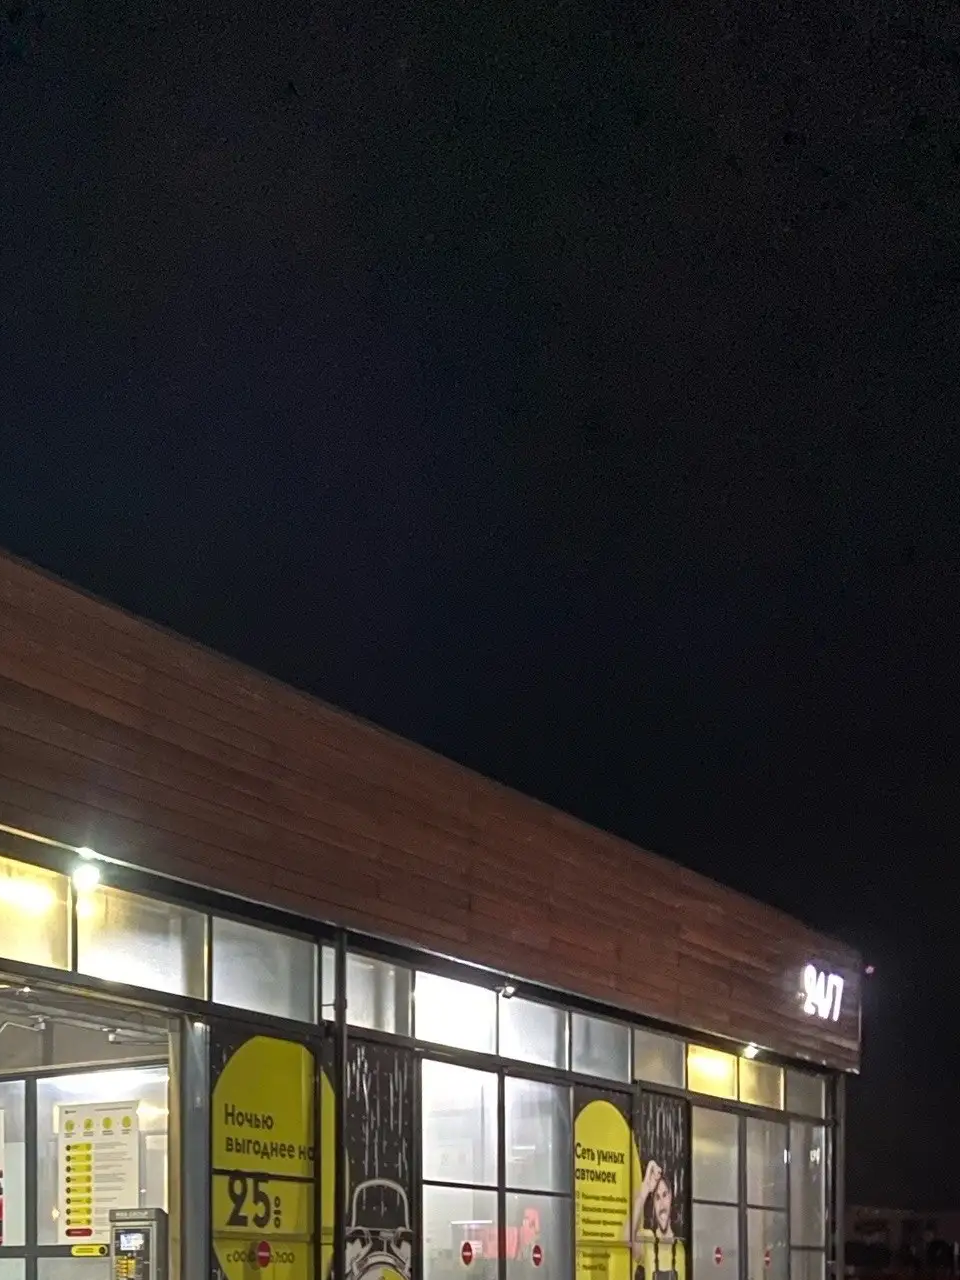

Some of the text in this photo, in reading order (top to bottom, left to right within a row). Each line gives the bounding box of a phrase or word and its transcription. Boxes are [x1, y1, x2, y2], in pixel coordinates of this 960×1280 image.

[224, 1103, 274, 1130] Ночью
[225, 1137, 296, 1160] выгоднее
[575, 1142, 625, 1166] Сеть умных
[575, 1168, 617, 1184] автомоек
